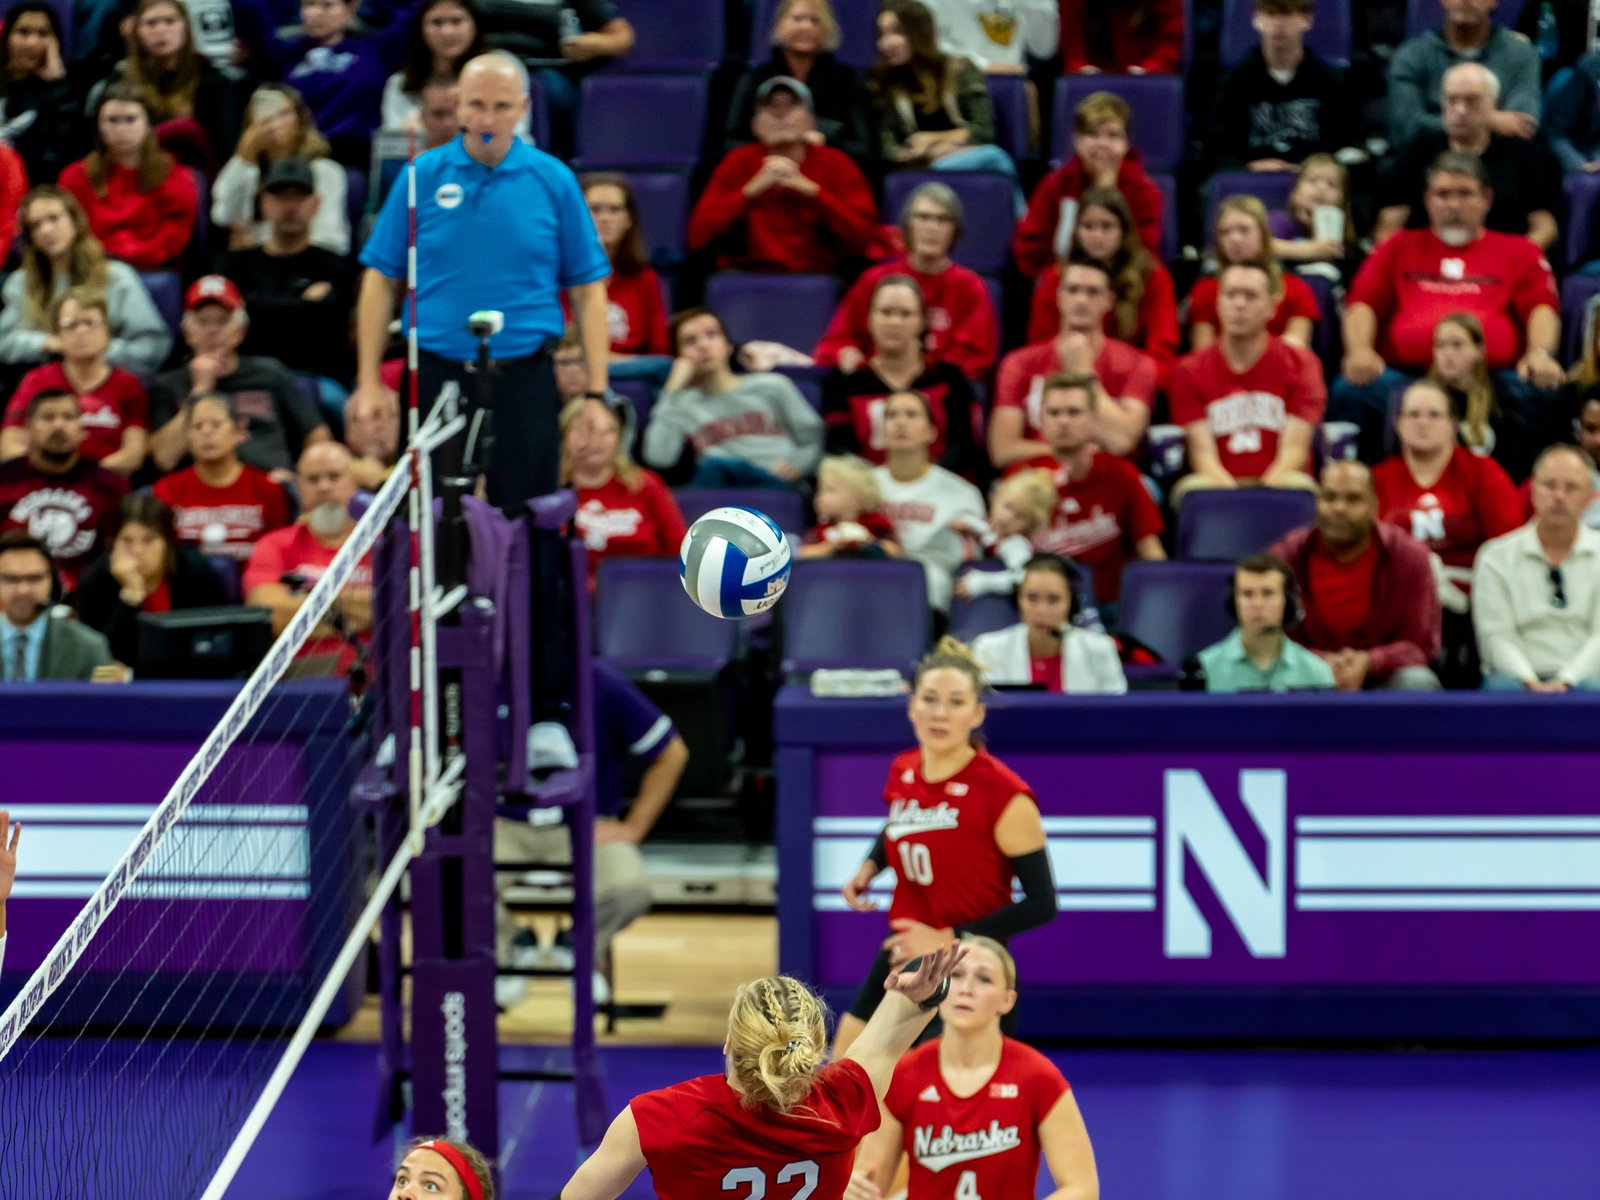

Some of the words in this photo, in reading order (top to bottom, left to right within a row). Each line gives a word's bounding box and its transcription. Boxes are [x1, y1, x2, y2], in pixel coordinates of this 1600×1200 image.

[1410, 508, 1446, 543] N
[888, 798, 960, 828] Nebraska
[897, 841, 934, 886] 10
[1164, 768, 1287, 959] N
[914, 1119, 1021, 1160] Nebraska
